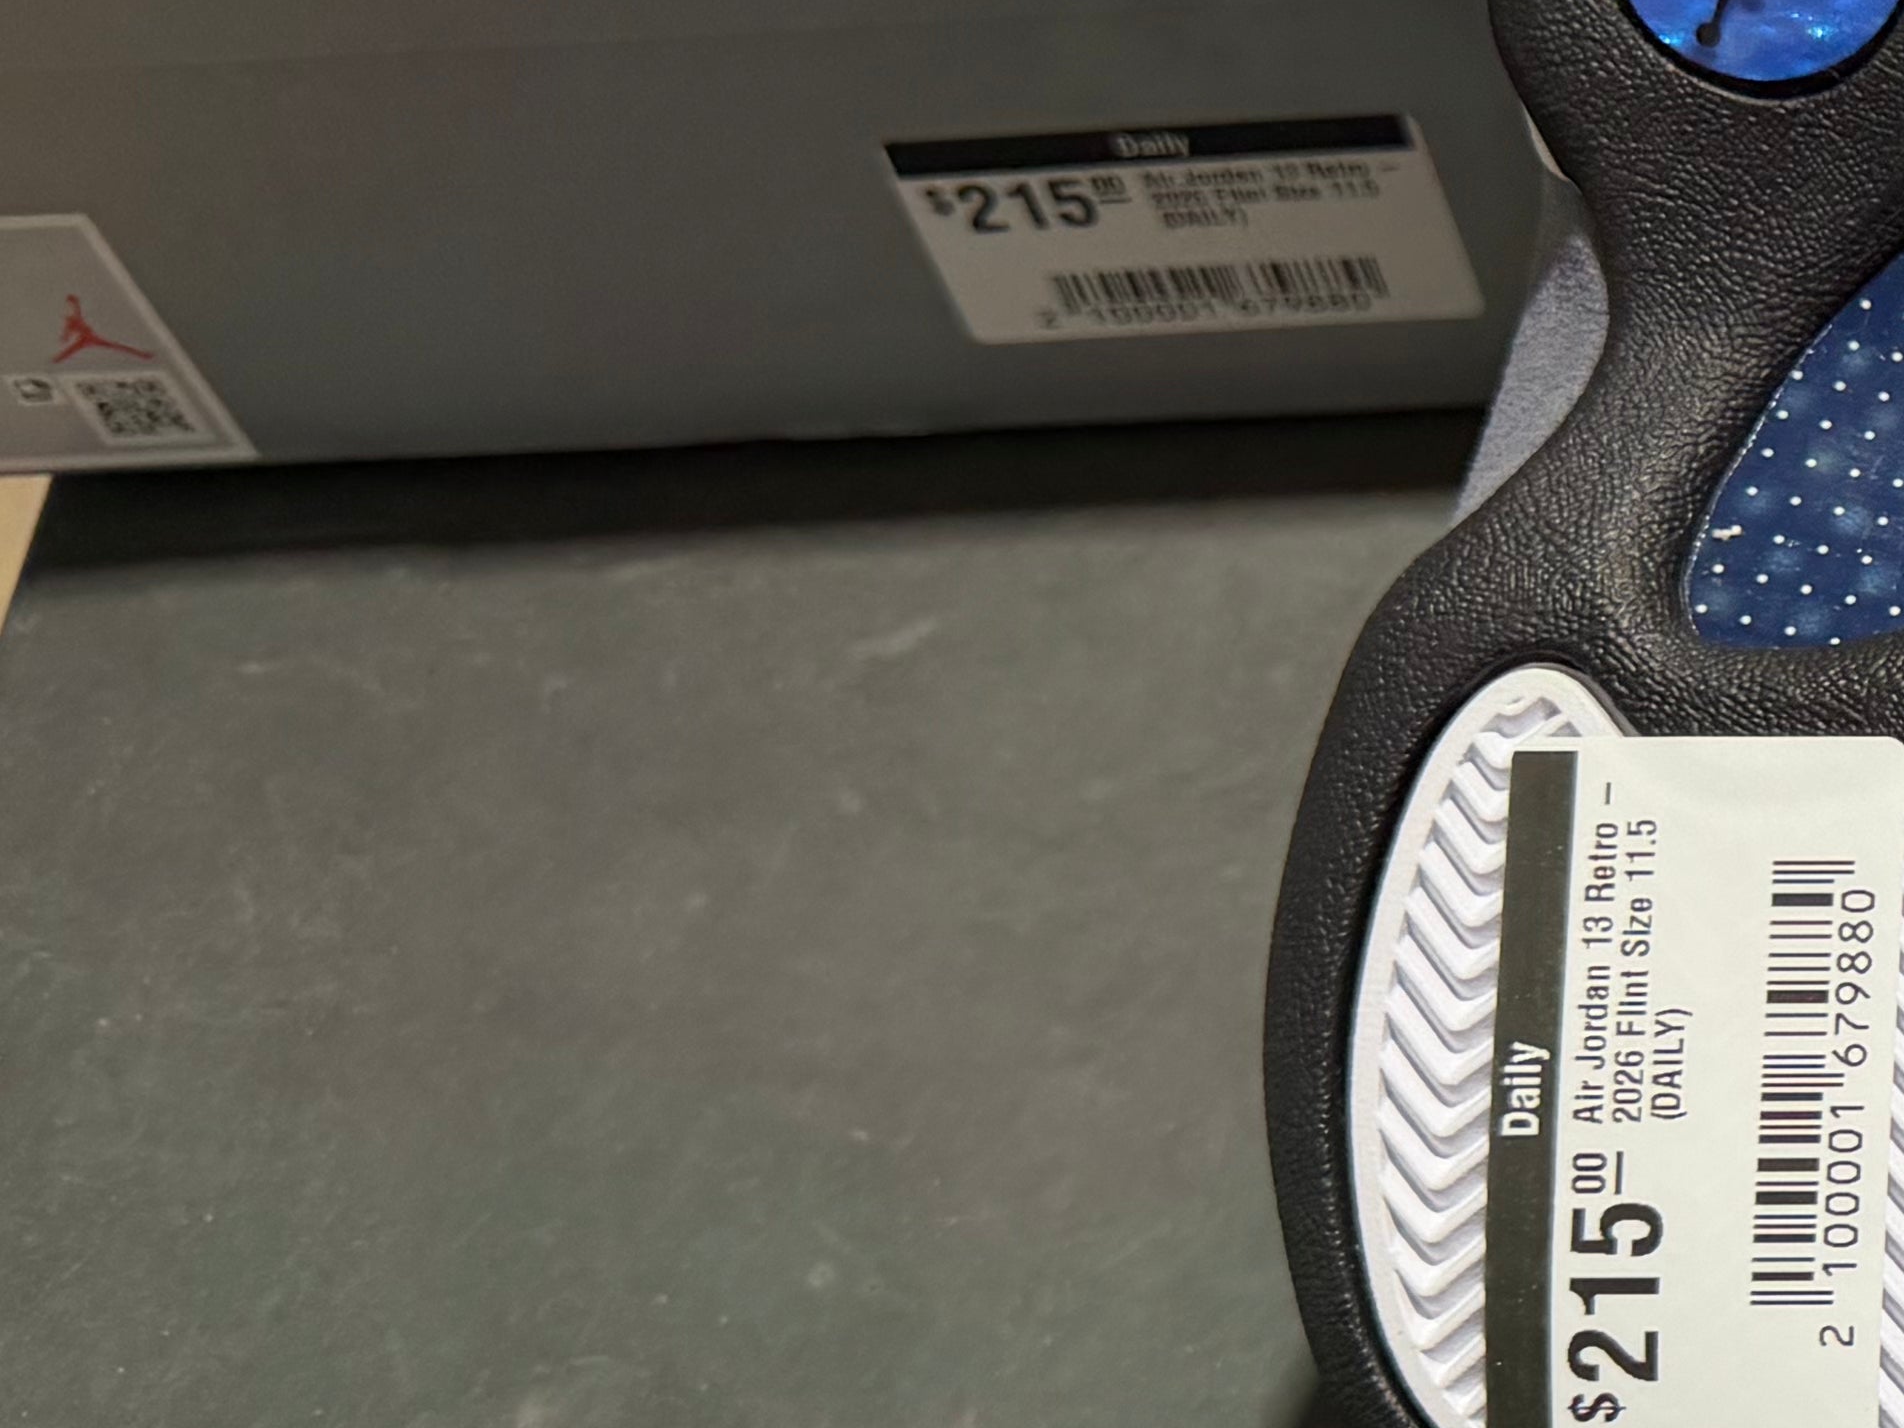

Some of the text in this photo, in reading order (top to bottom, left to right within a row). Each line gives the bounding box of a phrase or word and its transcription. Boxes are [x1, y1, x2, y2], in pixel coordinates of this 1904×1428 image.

[1116, 132, 1190, 159] Daily
[925, 176, 1100, 233] $215
[1584, 823, 1618, 902] Retro
[1581, 916, 1613, 948] 13
[1612, 820, 1657, 1123] 2026 Flint Size 11.5
[1575, 965, 1610, 1070] Jordan
[1650, 1008, 1693, 1120] (DAILY)
[1500, 1041, 1551, 1136] Daily
[1573, 1081, 1604, 1124] Air
[1819, 888, 1876, 1347] 2 100001 679880
[1567, 1203, 1664, 1422] $215
